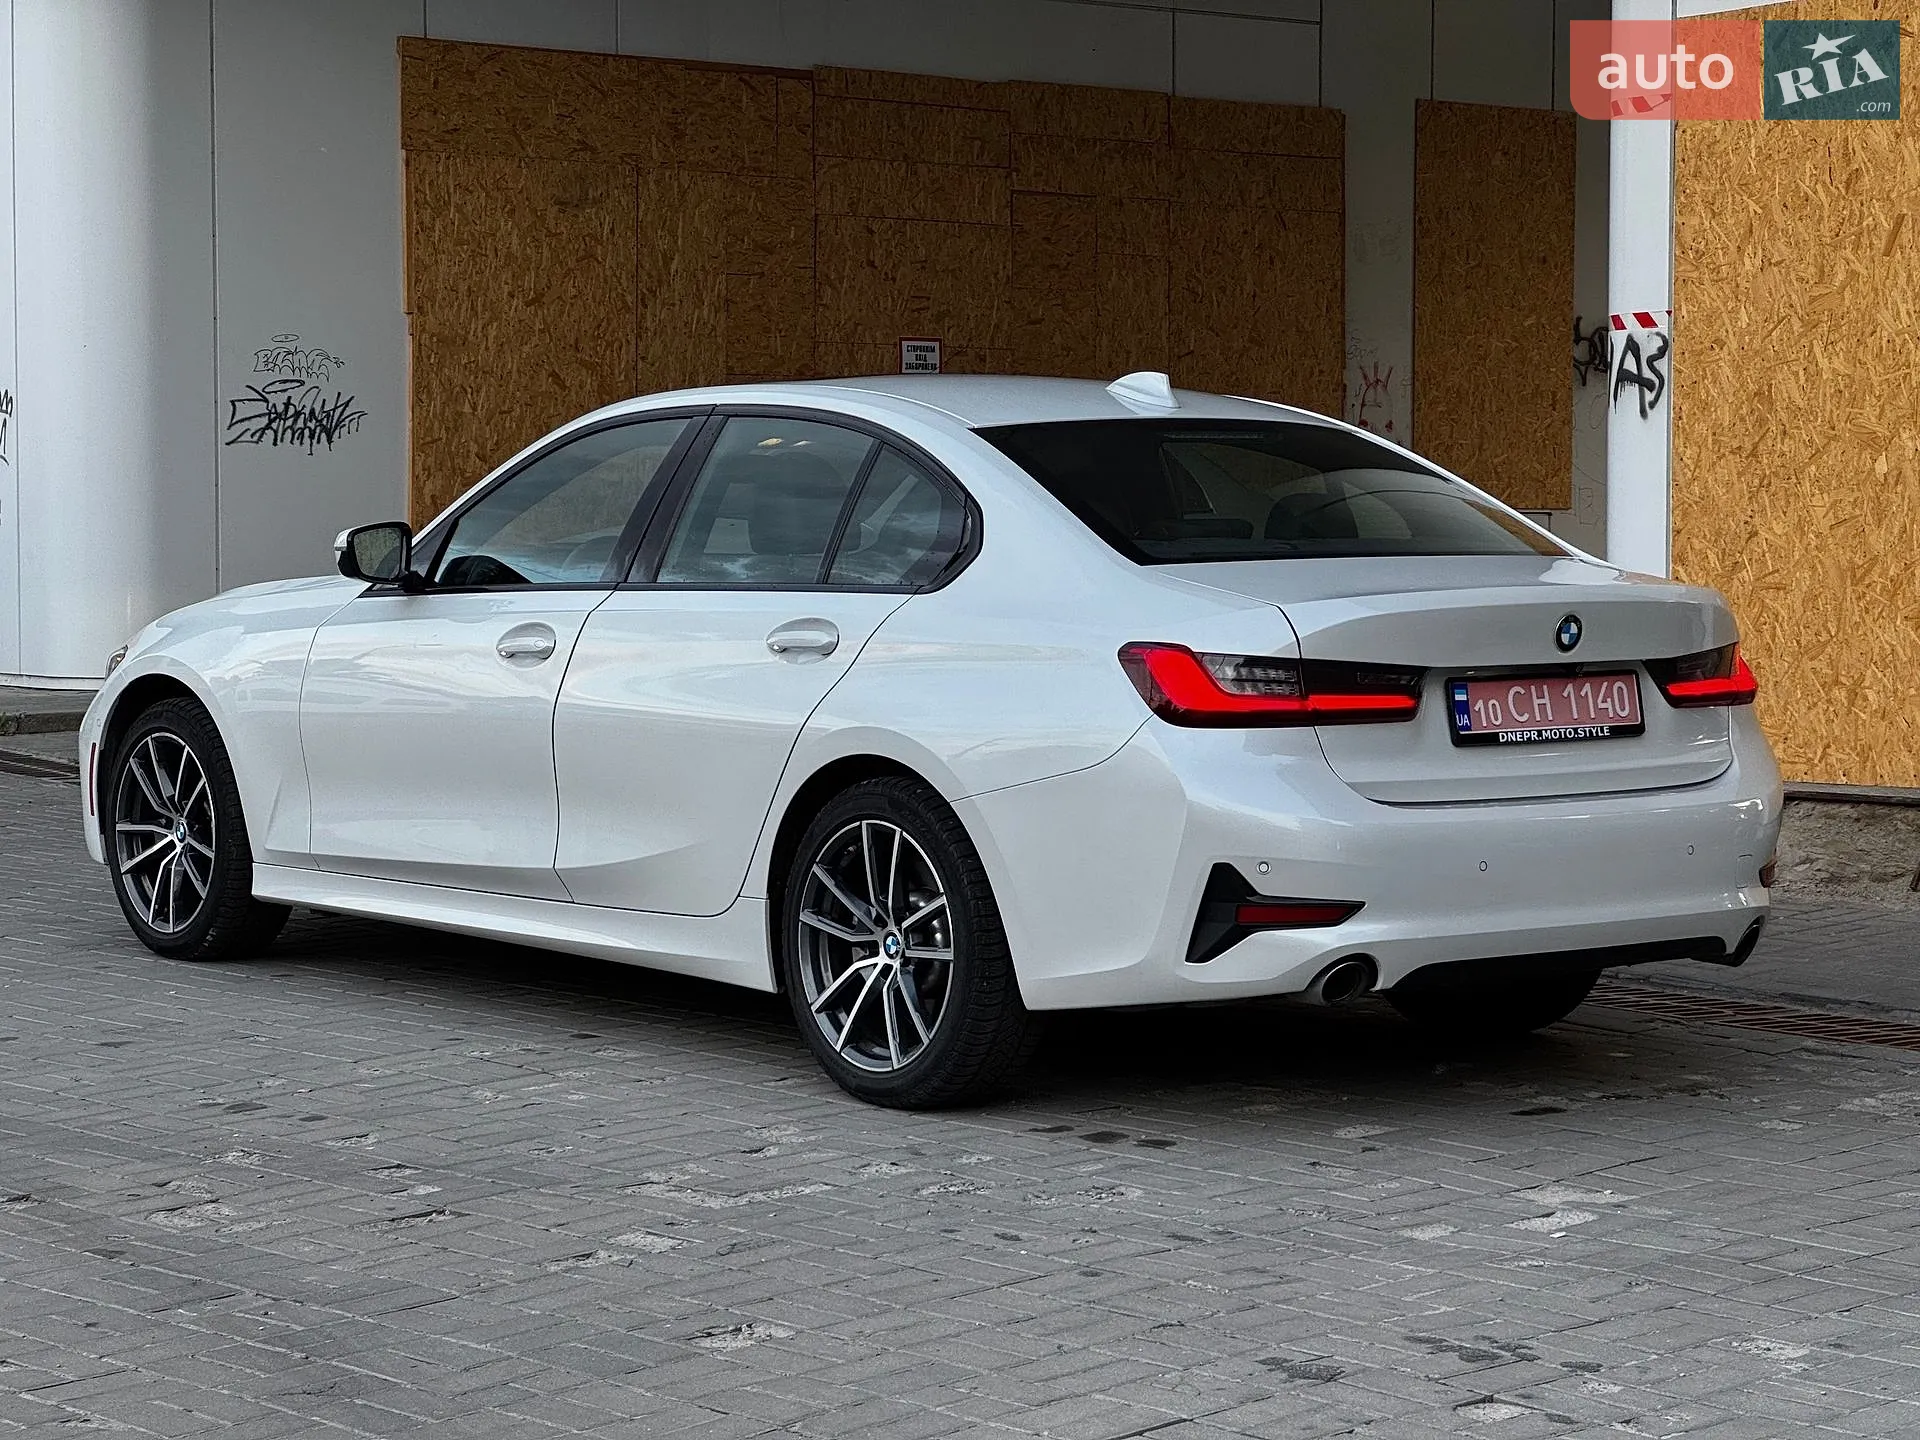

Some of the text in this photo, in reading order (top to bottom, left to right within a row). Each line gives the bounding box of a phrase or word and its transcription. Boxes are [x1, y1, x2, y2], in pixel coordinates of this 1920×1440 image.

[1473, 680, 1631, 728] 10 CH 1140
[1456, 714, 1470, 727] UA
[1499, 725, 1611, 743] DNEPR.MOTO.STYLE
